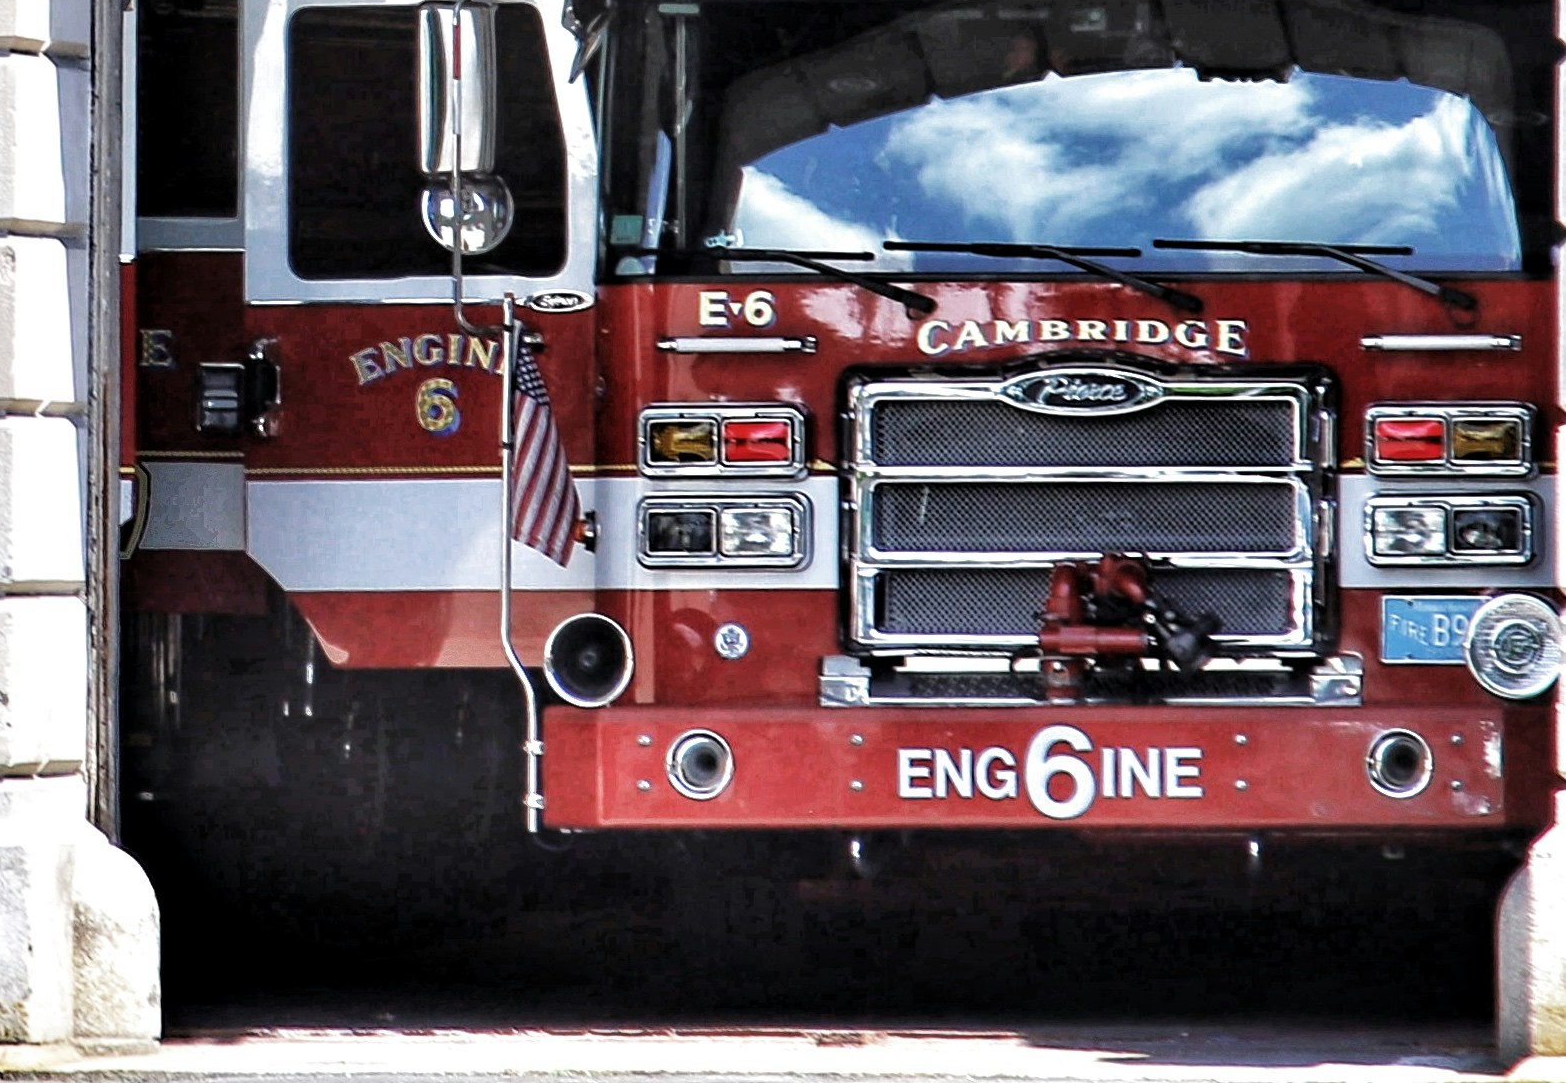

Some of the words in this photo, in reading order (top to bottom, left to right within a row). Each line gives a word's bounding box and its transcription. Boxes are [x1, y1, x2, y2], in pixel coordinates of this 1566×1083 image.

[348, 333, 504, 386] ENGIN
[917, 319, 1250, 357] CAMBRIDGE
[416, 378, 460, 436] 6
[1389, 613, 1429, 646] FIRE
